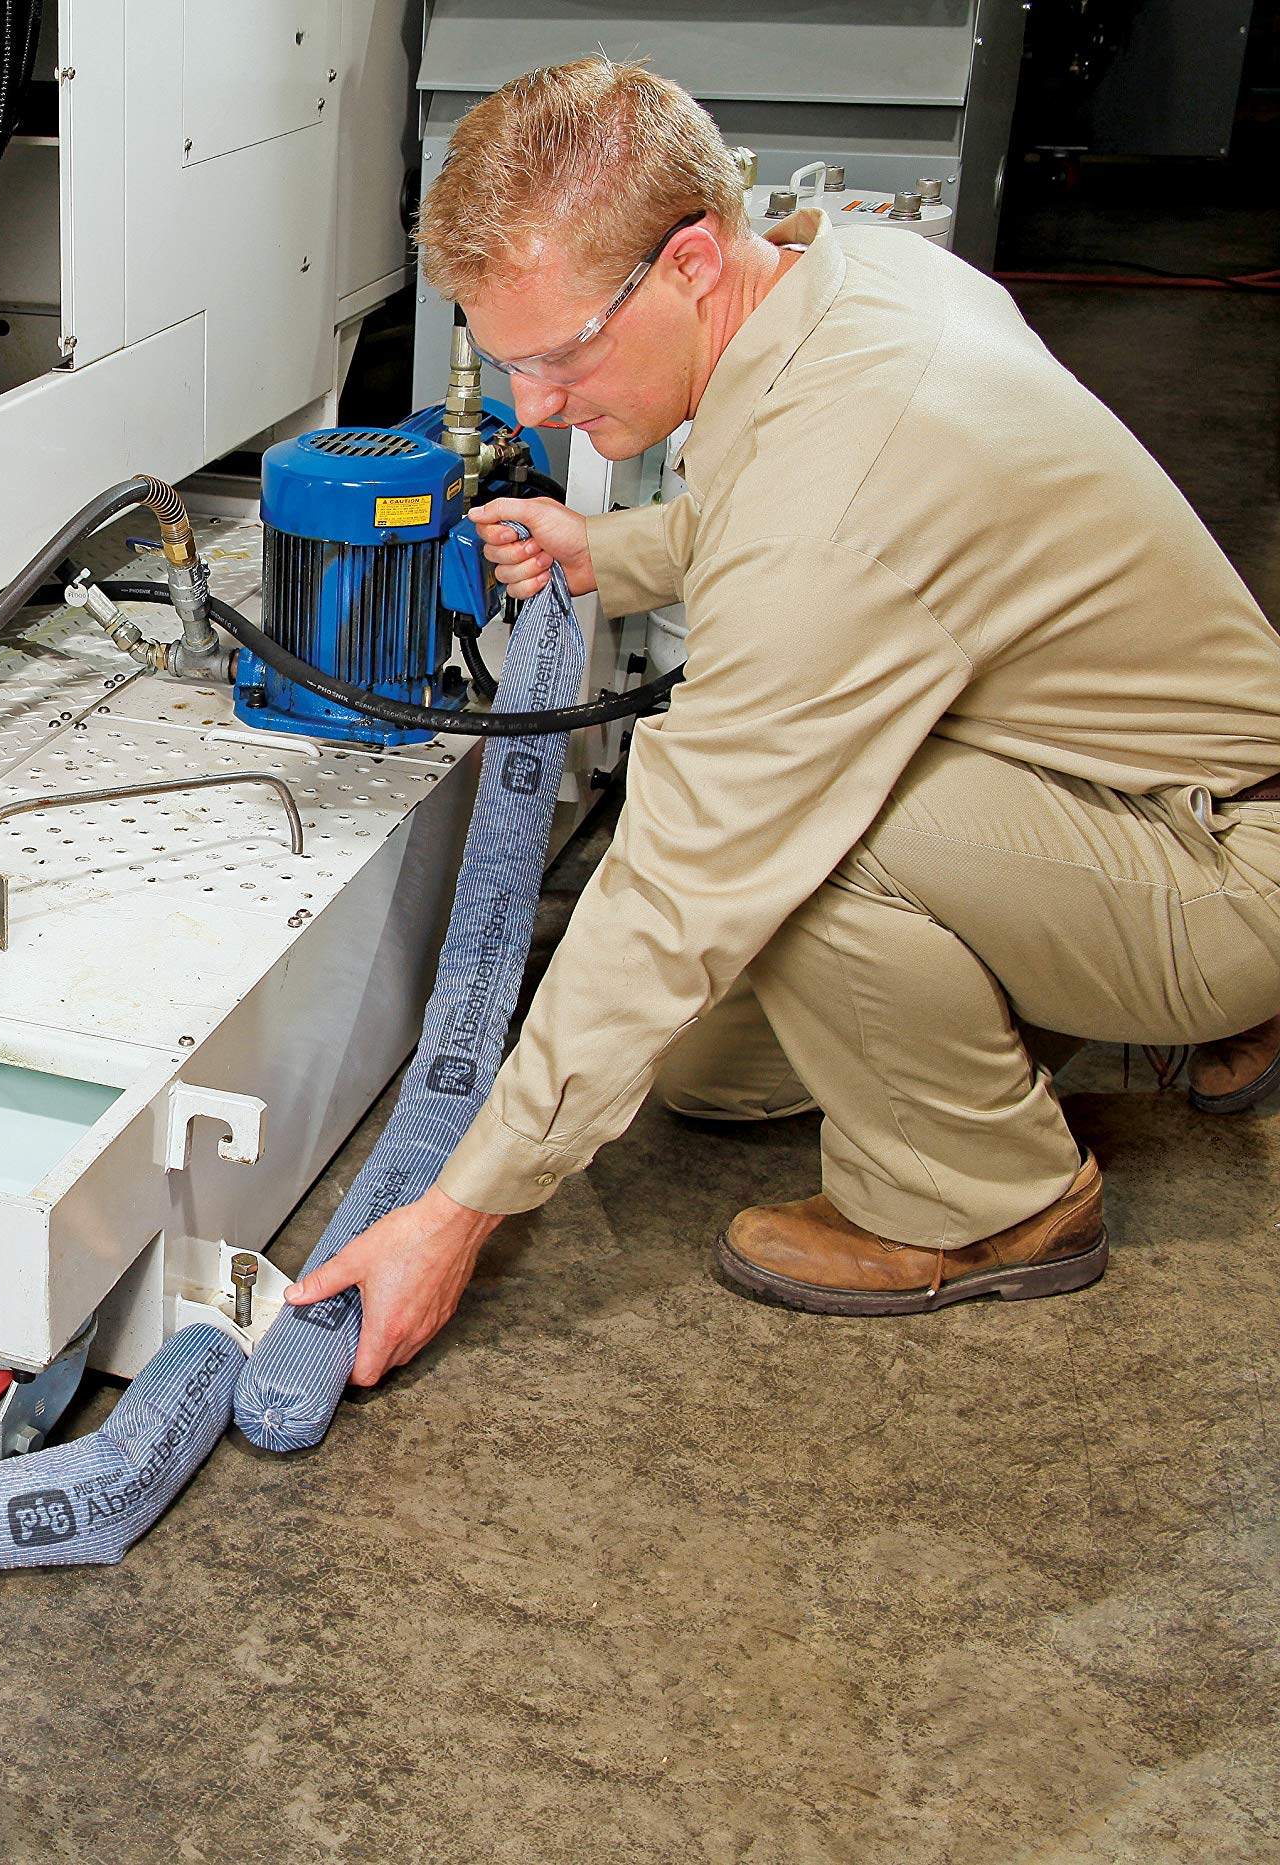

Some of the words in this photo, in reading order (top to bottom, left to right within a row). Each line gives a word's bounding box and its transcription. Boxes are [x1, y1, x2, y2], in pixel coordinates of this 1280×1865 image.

[538, 609, 560, 652] Sock
[317, 684, 349, 702] PHOENIX
[451, 944, 500, 1052] Absorbent
[483, 889, 512, 940] Sock
[86, 1400, 195, 1527] Absorbent
[185, 1343, 229, 1406] Sock
[96, 1469, 124, 1489] Blue
